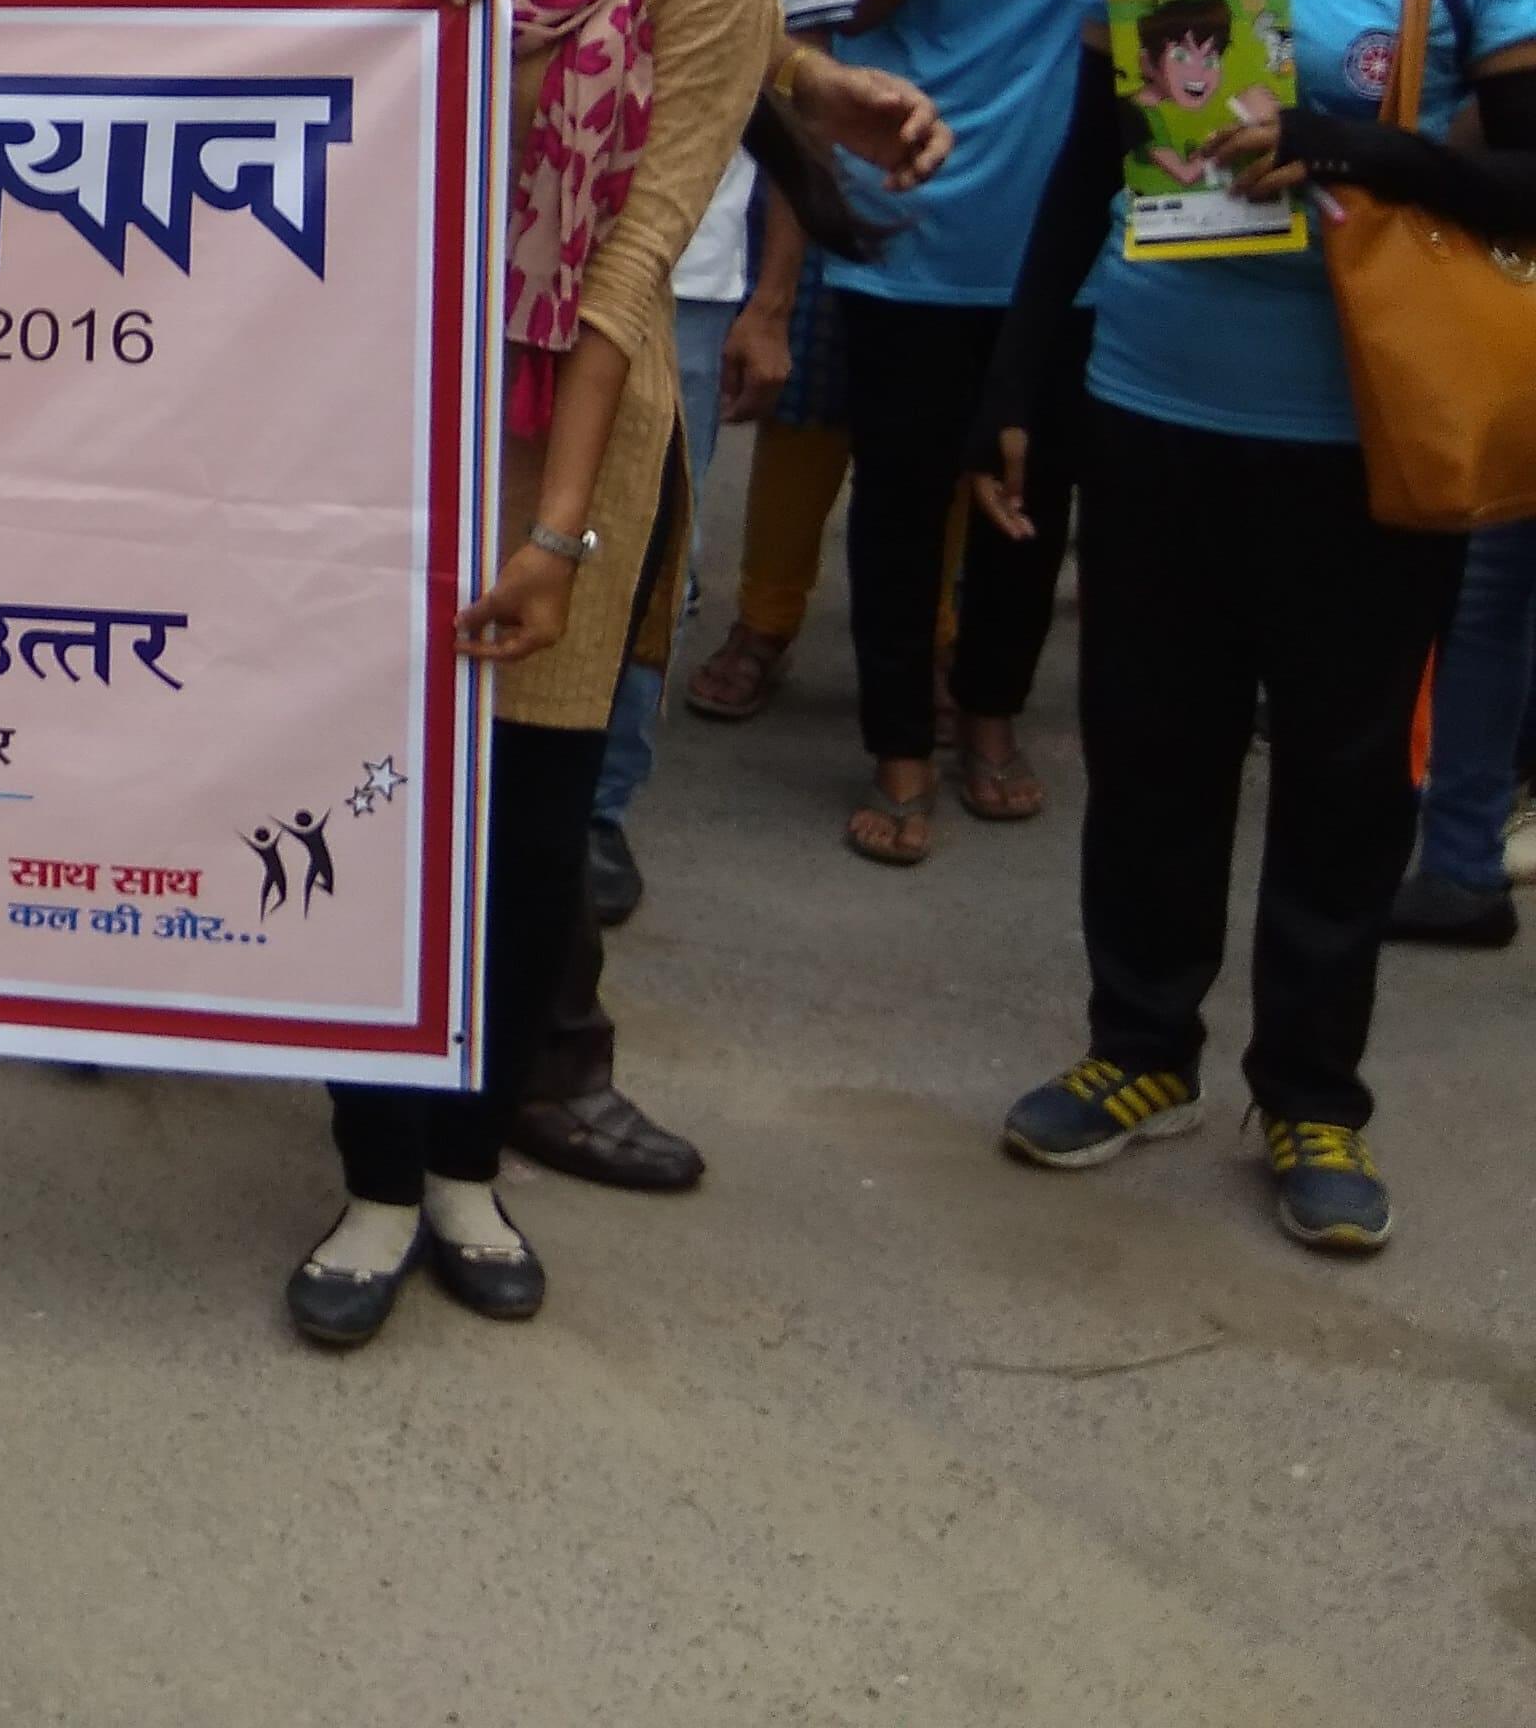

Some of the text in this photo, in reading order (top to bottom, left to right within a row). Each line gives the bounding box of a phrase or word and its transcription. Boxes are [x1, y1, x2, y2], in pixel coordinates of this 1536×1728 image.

[9, 856, 203, 898] साथ साथ
[8, 902, 80, 931] कल
[89, 903, 141, 936] की
